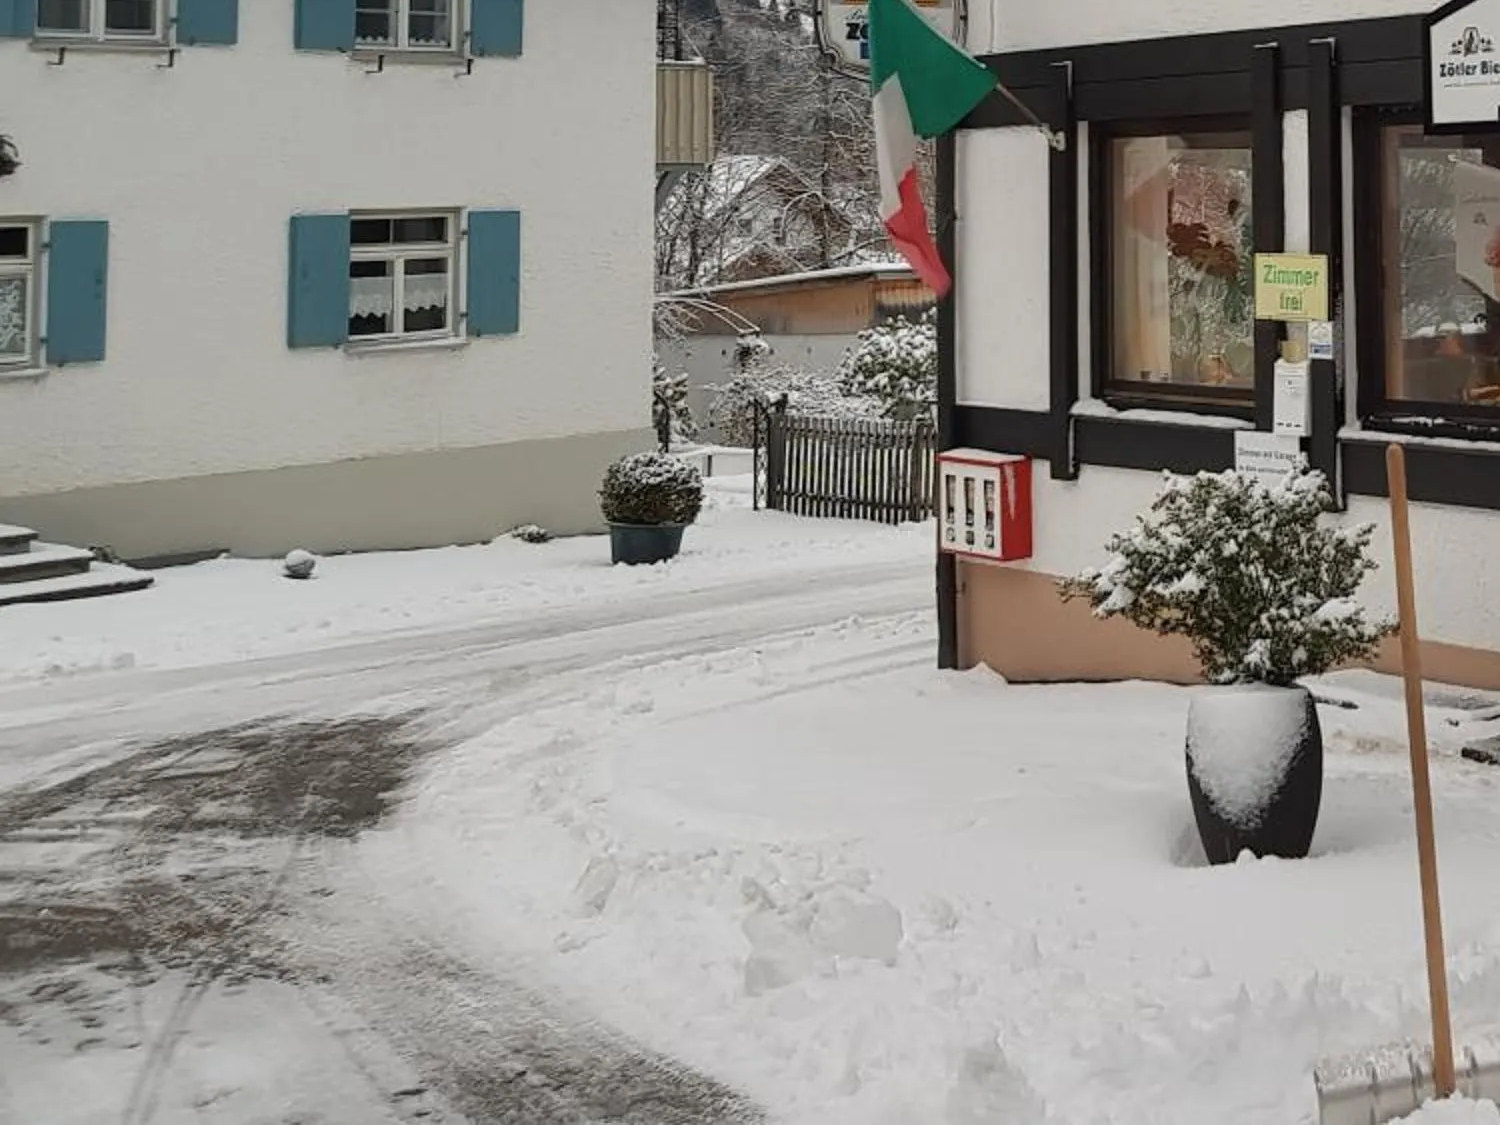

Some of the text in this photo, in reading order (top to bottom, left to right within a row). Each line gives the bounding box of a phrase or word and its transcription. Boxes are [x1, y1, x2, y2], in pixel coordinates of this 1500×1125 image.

[1439, 61, 1478, 78] Zötler
[1262, 263, 1320, 287] Zimmer
[1278, 290, 1304, 312] frei
